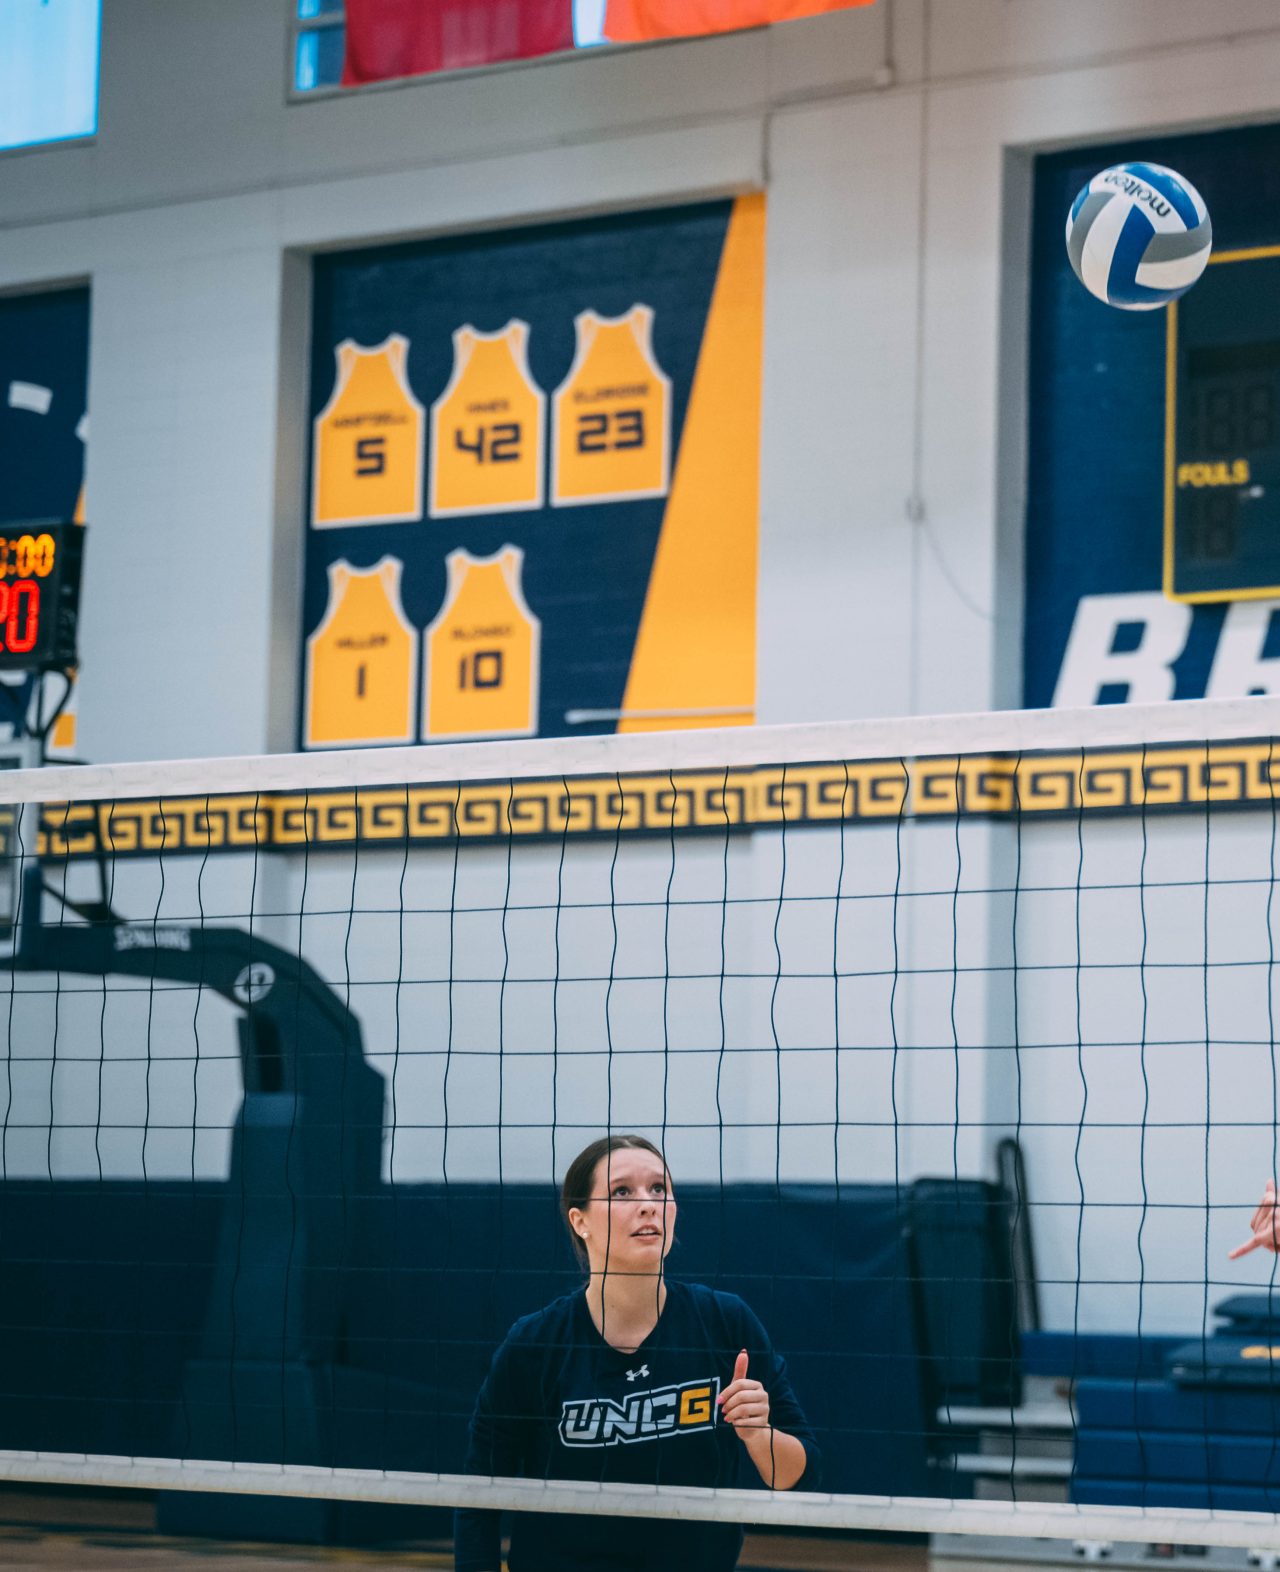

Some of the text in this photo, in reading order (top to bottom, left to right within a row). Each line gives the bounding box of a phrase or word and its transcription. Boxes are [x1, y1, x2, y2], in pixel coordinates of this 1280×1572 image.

[455, 423, 521, 464] 42
[577, 409, 645, 454] 23
[355, 437, 386, 477] 5
[1177, 460, 1250, 487] FOULS
[0, 534, 55, 578] :00
[459, 649, 504, 691] 10
[564, 1386, 712, 1441] UNCG
